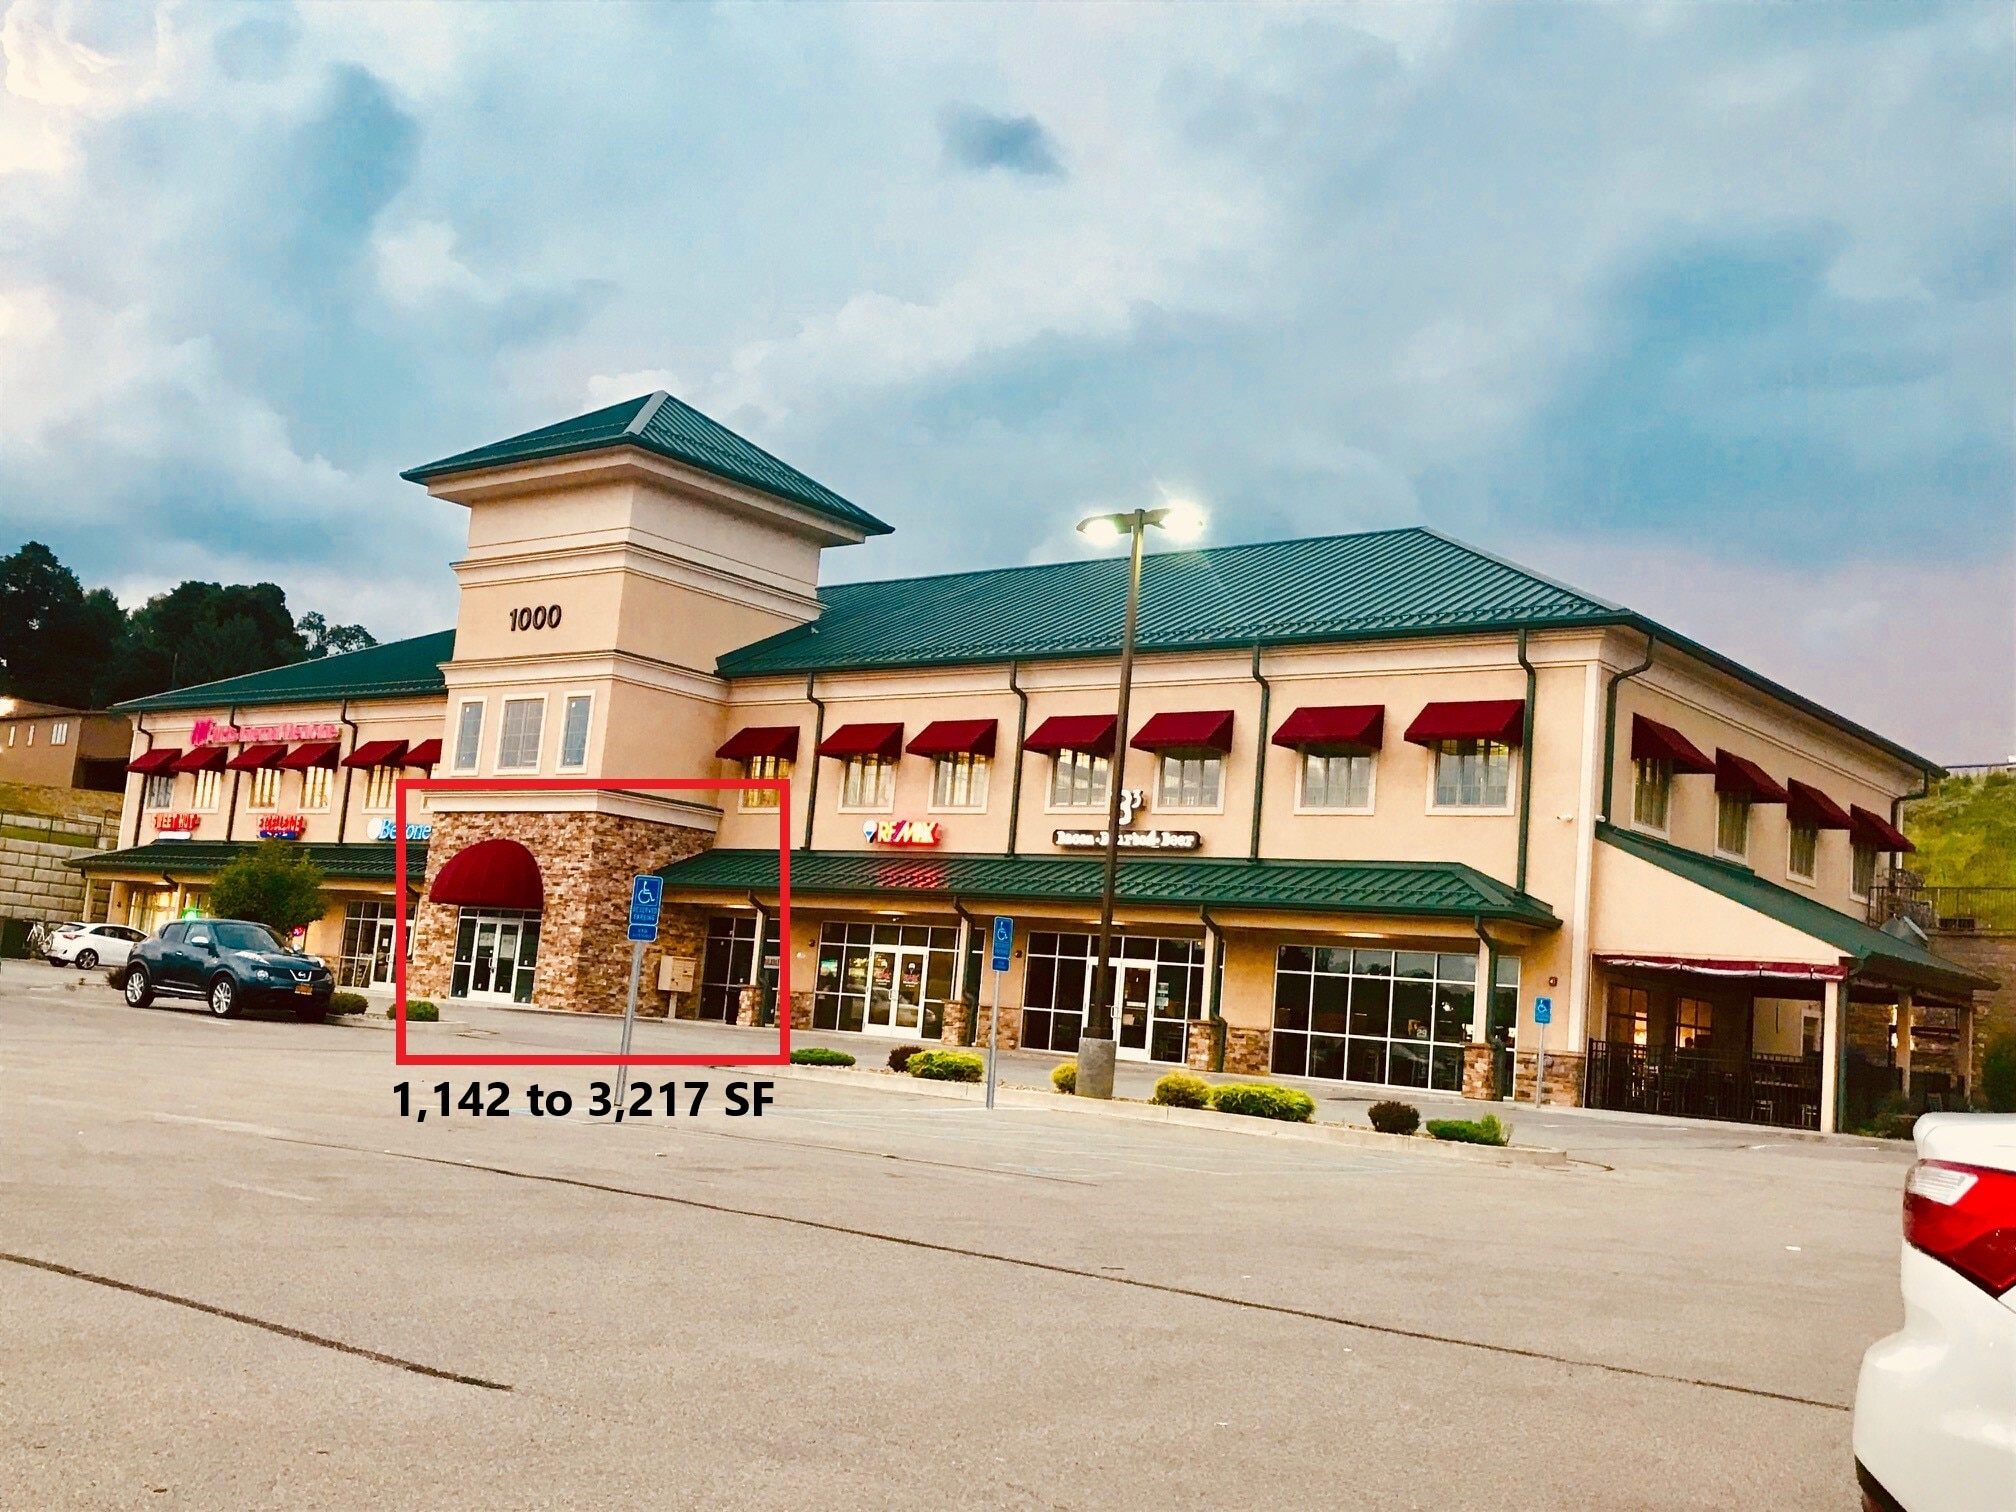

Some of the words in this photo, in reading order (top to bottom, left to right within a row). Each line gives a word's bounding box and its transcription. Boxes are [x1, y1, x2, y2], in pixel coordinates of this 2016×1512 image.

[509, 604, 562, 632] 1000
[379, 818, 432, 840] Beone
[1099, 830, 1156, 848] Burbon
